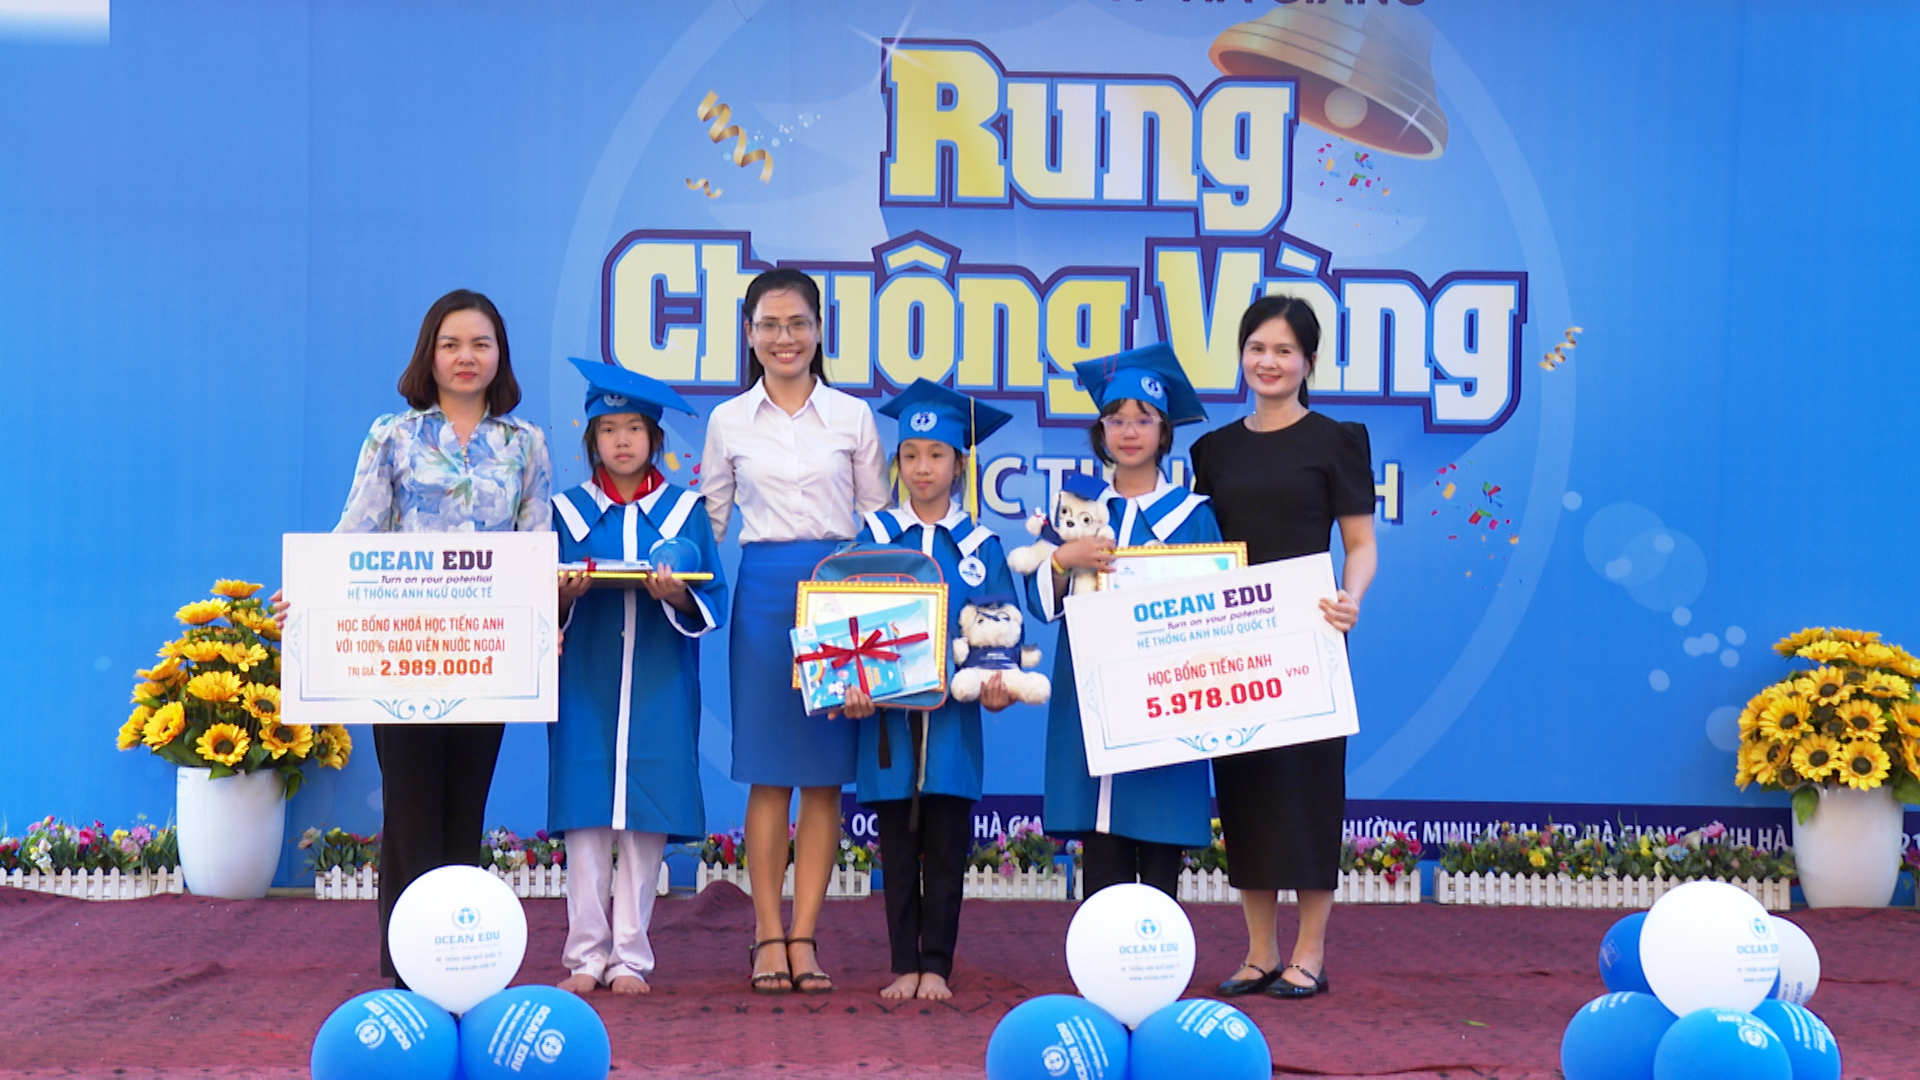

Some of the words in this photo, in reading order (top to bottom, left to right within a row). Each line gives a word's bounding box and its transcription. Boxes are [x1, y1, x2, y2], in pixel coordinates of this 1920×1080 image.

[883, 39, 1297, 235] Rung
[604, 231, 1137, 424] Chuông
[1147, 236, 1526, 432] Vàng
[349, 550, 433, 571] OCEAN
[443, 550, 493, 570] EDU
[381, 575, 401, 584] Turn
[420, 577, 443, 585] your
[446, 575, 492, 585] potential
[348, 587, 360, 602] HỆ
[401, 587, 423, 599] ANH
[1133, 592, 1215, 622] OCEAN
[1222, 583, 1272, 608] EDU
[337, 619, 359, 635] HỌC
[393, 616, 421, 632] KHOÁ
[425, 618, 446, 633] HỌC
[449, 614, 479, 631] TIẾNG
[483, 618, 504, 631] ANH
[1167, 616, 1188, 630] Turn
[1189, 618, 1203, 626] on
[1205, 612, 1228, 626] your
[1230, 605, 1275, 621] potential
[336, 638, 352, 653] VỚI
[356, 639, 385, 653] 100%
[388, 638, 412, 653] GIÁO
[415, 636, 439, 652] VIÊN
[474, 636, 505, 652] NGOÀI
[1189, 628, 1210, 641] ANH
[380, 656, 493, 676] 2.989.000đ
[1148, 669, 1172, 687] HỌC
[1209, 656, 1244, 675] TIẾNG
[1247, 654, 1272, 669] ANH
[1146, 677, 1283, 719] 5.978.000
[1285, 666, 1310, 678] VNĐ
[974, 811, 1002, 838] HÀ
[1341, 815, 1418, 845] HƯỜNG
[1423, 821, 1481, 845] MINH
[1758, 824, 1789, 850] HÀ
[434, 934, 474, 945] OCEAN
[478, 930, 500, 941] EDU
[1119, 944, 1157, 954] OCEAN
[1160, 942, 1179, 952] EDU
[1736, 945, 1768, 954] OCEAN
[522, 1005, 552, 1043] OCEAN
